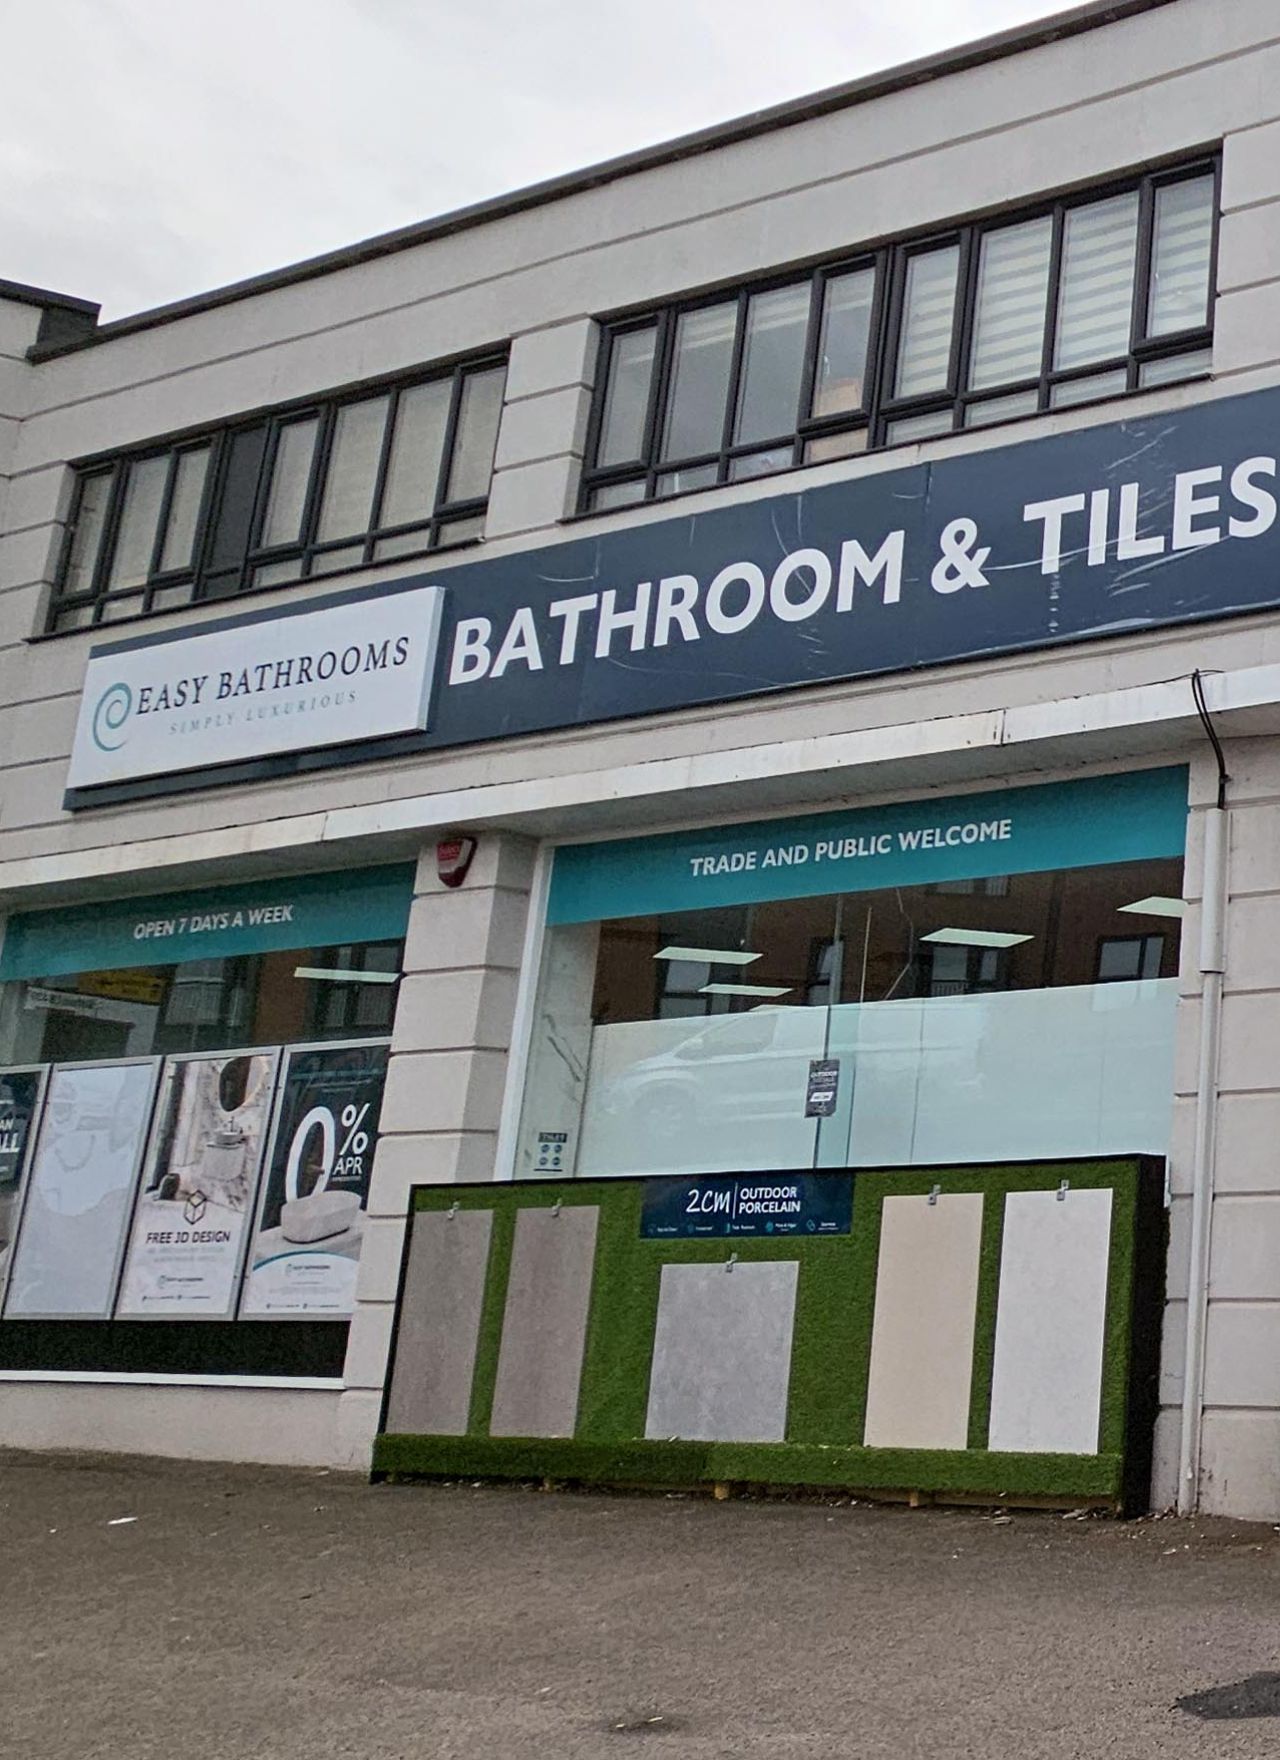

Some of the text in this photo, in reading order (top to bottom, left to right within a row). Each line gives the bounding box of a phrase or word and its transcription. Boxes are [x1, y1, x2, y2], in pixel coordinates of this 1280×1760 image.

[449, 456, 1279, 686] BATHROOM & TILES
[136, 636, 410, 715] EASY BATHROOMS
[169, 690, 358, 736] SIMPLY LUXURIOUS
[689, 818, 1012, 877] TRADE AND PUBLIC WELCOME
[133, 904, 294, 940] OPEN 7 DAYS A WEEK
[333, 1156, 363, 1176] APR
[738, 1200, 801, 1214] PORCELAIN
[739, 1185, 798, 1200] OUTDOOR
[146, 1231, 173, 1244] FREE
[191, 1230, 231, 1244] DESIGN
